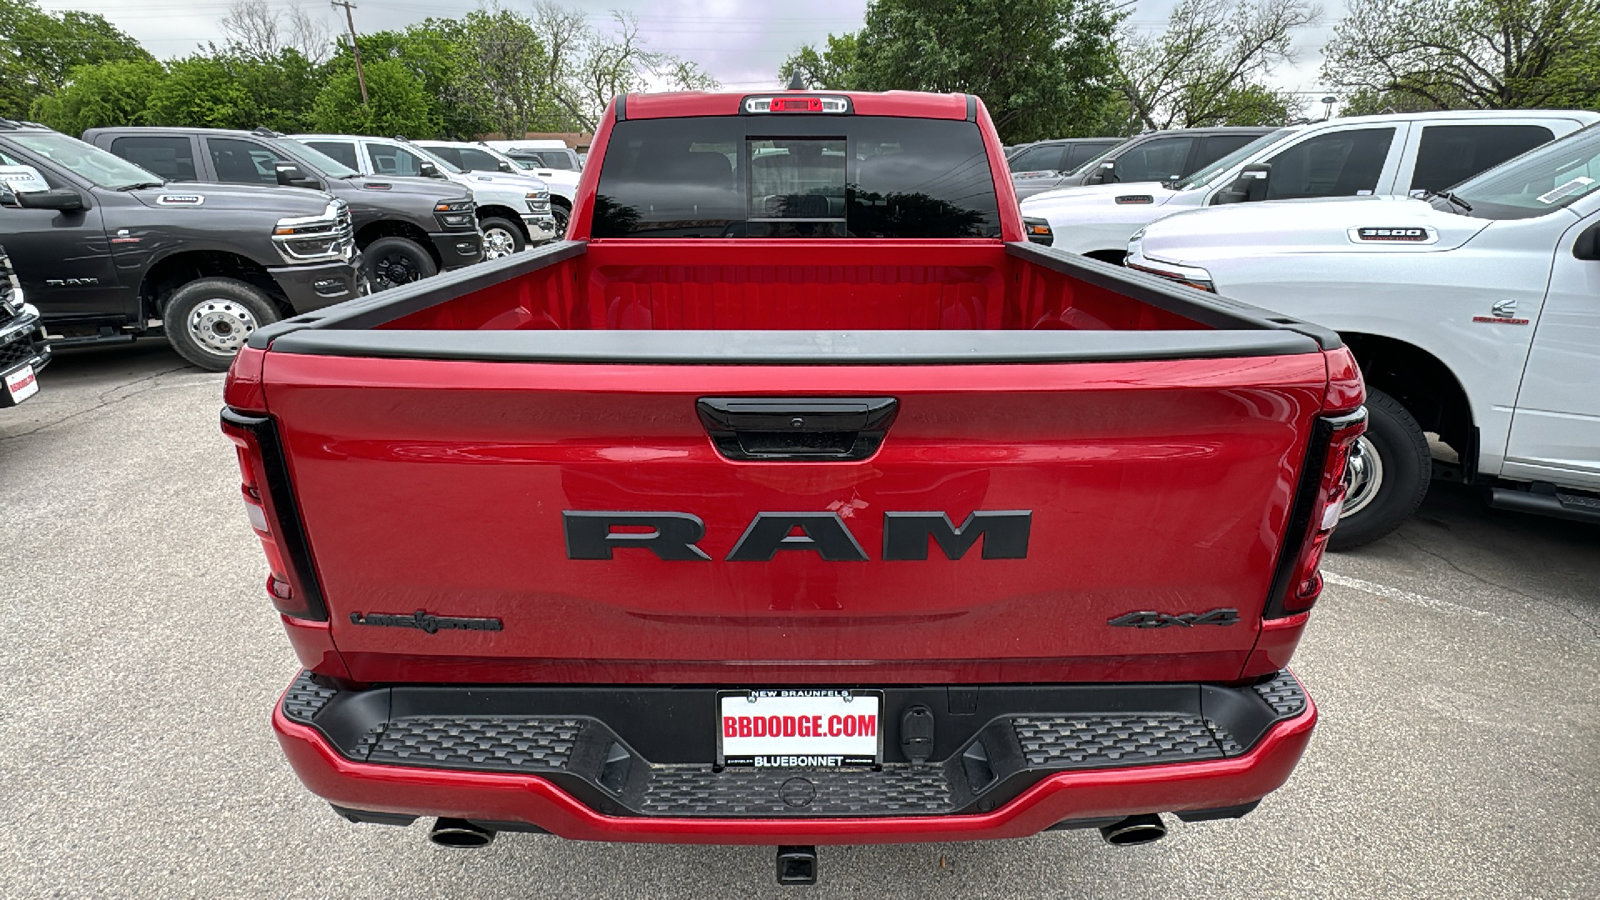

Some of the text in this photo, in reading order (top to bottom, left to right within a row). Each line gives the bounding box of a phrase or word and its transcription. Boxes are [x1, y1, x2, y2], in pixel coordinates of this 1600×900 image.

[562, 510, 1032, 561] RAM
[723, 714, 877, 738] BBDODGE.COM
[754, 756, 844, 767] BLUEBONNET
